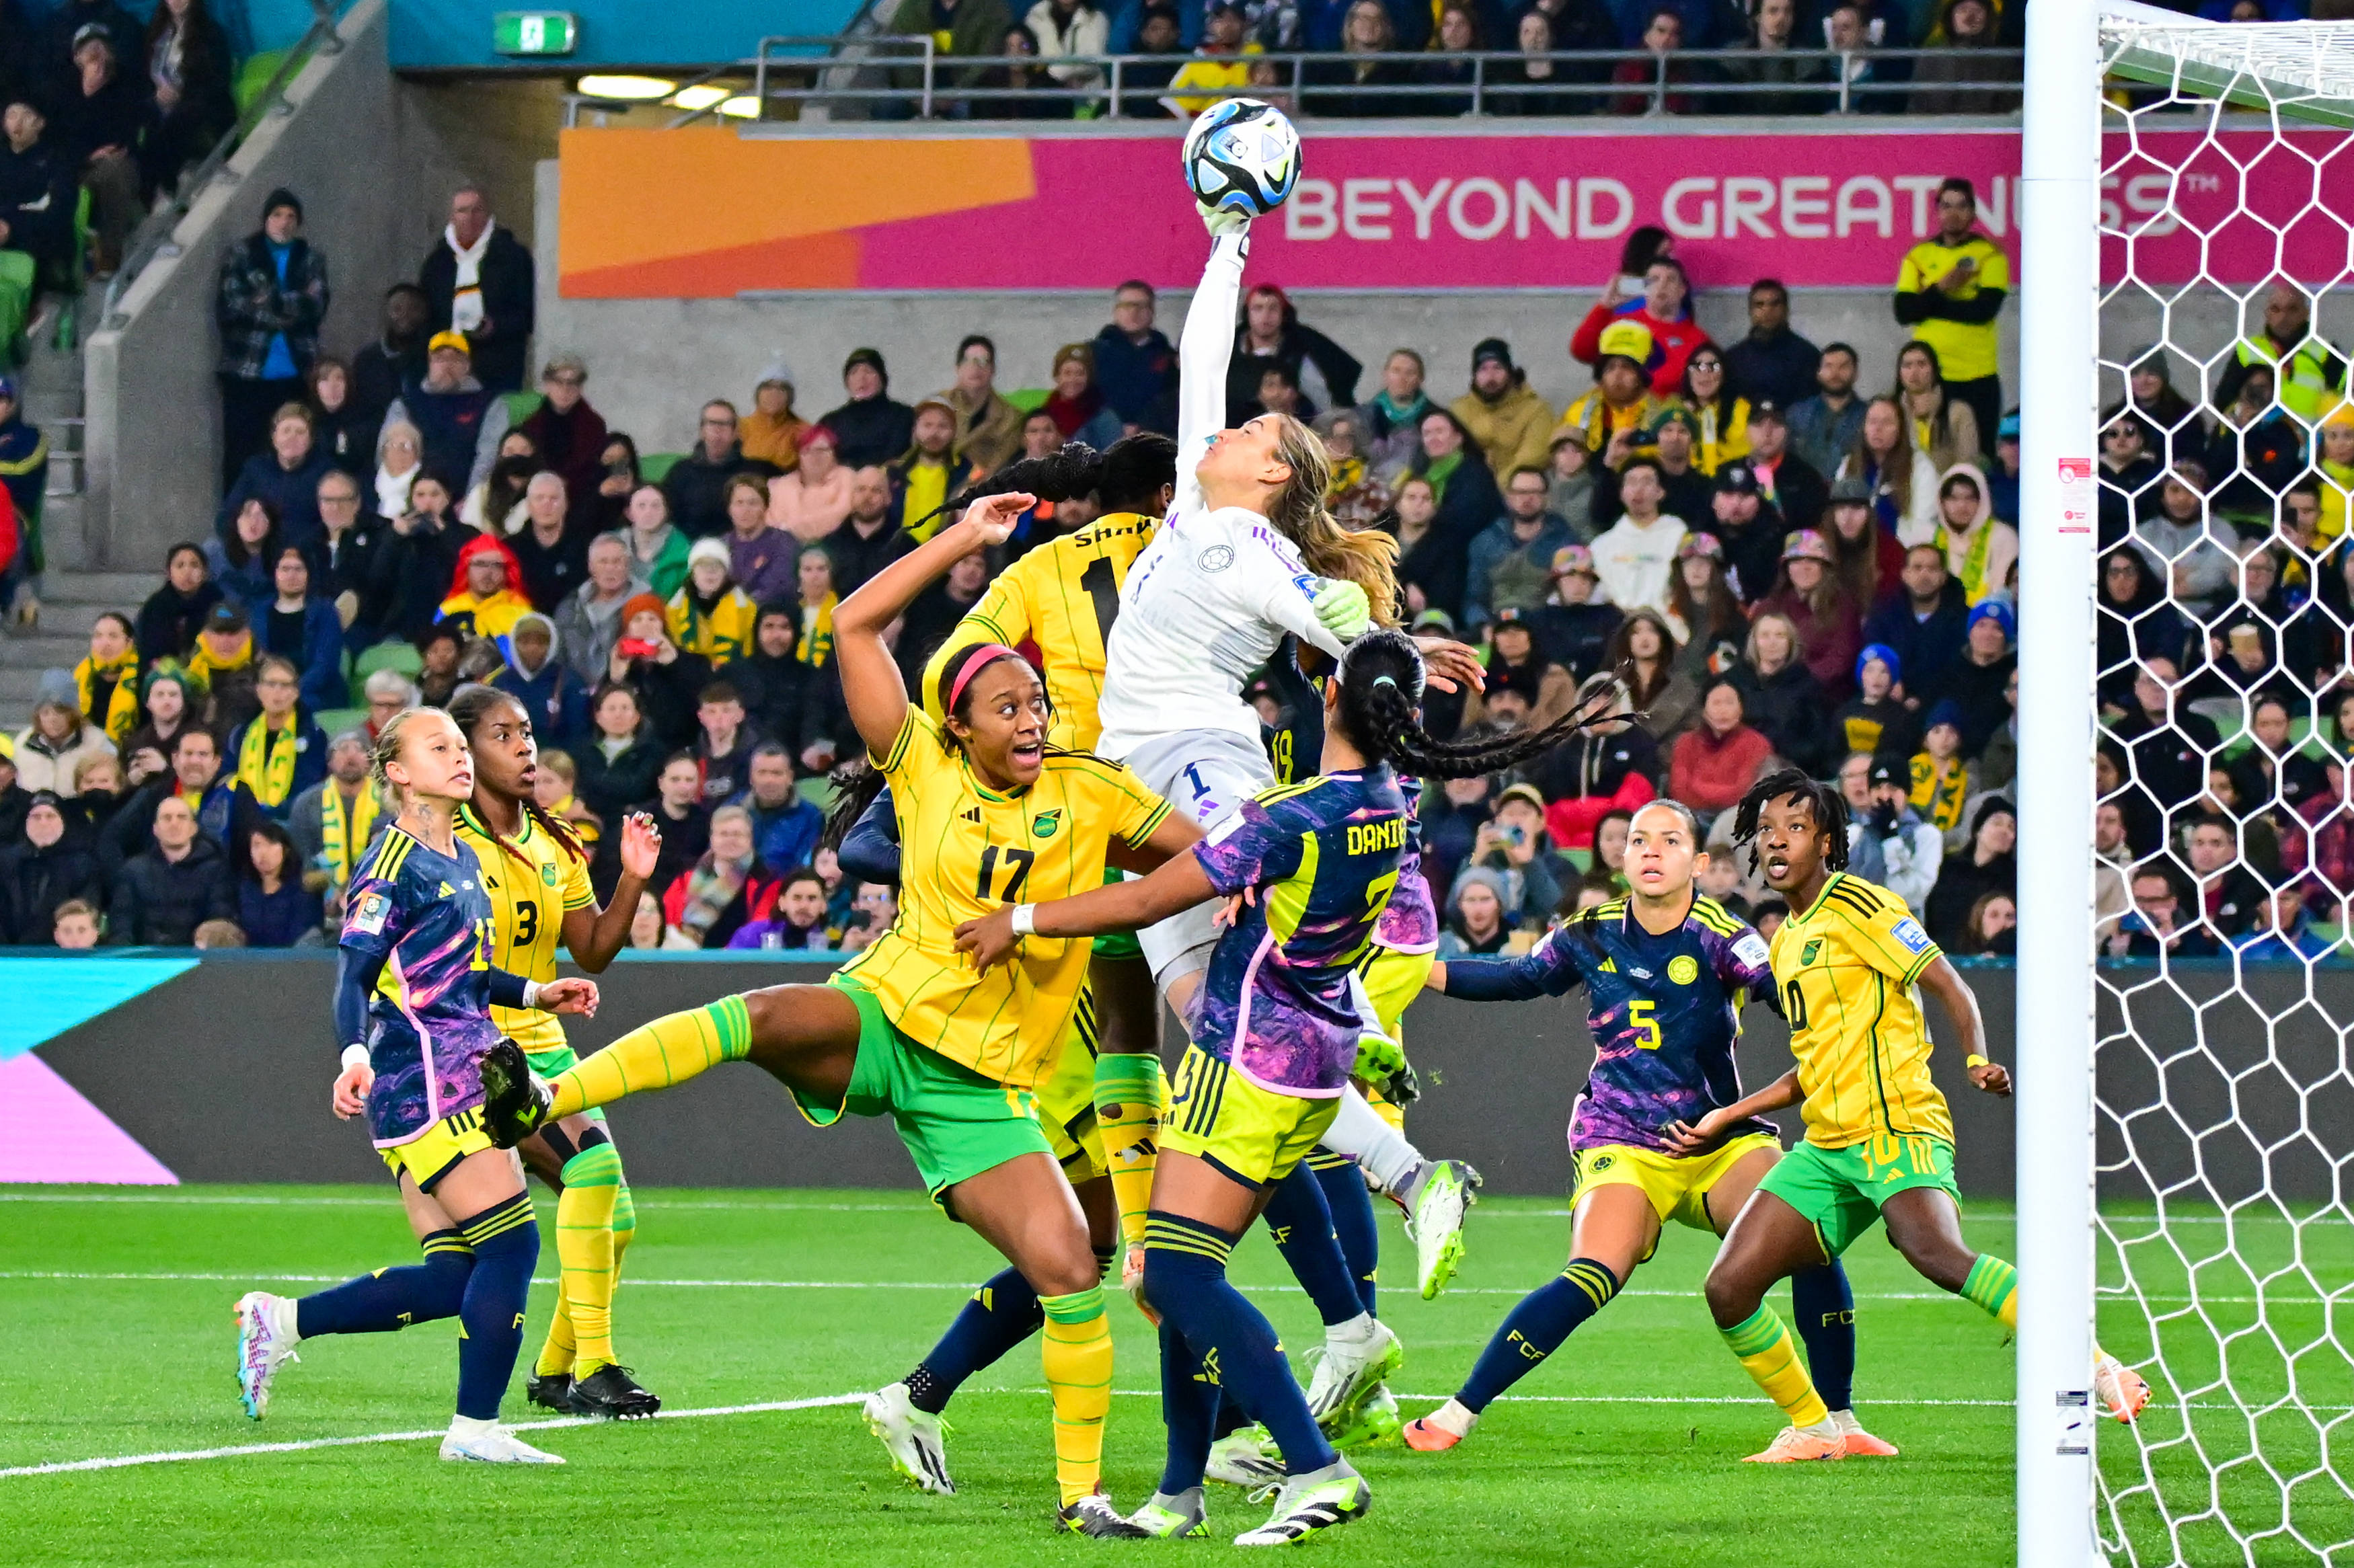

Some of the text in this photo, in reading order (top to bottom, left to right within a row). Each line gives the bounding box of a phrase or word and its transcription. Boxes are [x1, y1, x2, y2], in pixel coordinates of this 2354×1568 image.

[1285, 178, 1633, 241] BEYOND
[1661, 175, 2180, 239] GREATNS
[1183, 762, 1211, 801] 1
[976, 845, 1035, 903] 17
[513, 901, 537, 947] 3
[1629, 1001, 1661, 1050] 5
[1507, 1329, 1546, 1360] FCF
